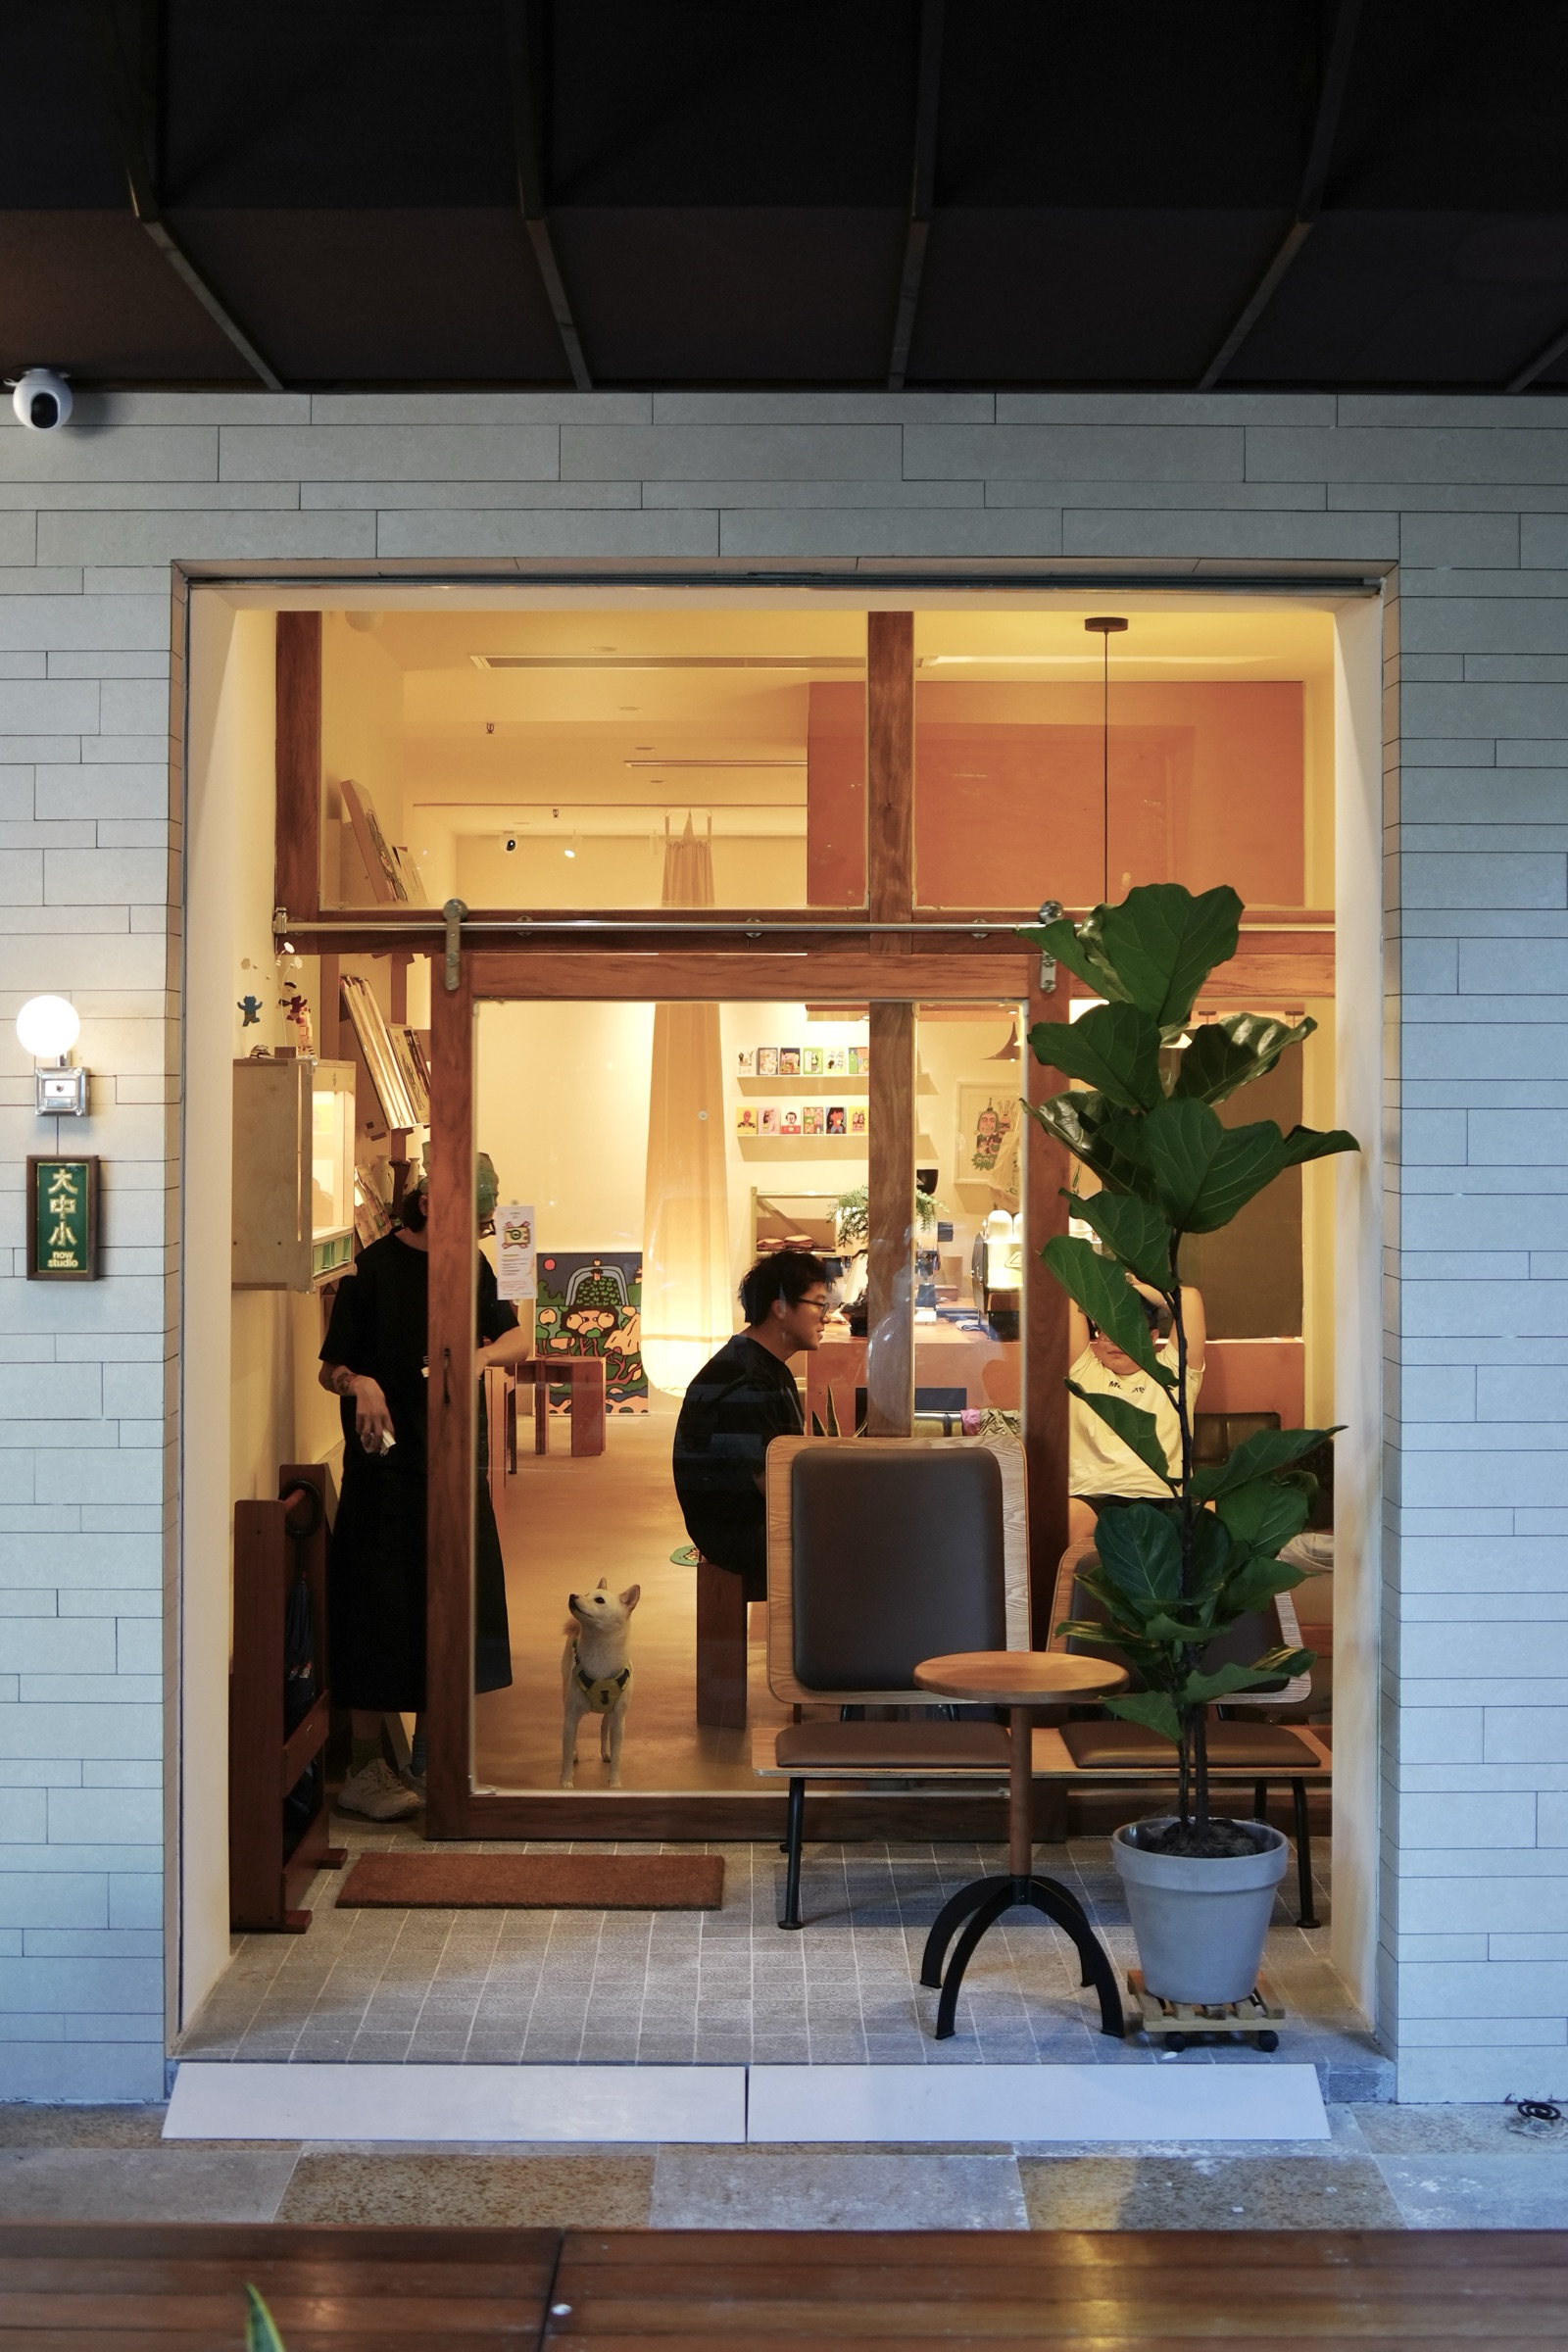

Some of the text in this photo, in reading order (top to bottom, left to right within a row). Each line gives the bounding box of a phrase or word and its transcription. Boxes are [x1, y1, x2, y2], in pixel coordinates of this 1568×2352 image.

[48, 1168, 78, 1247] 大中小
[52, 1250, 74, 1259] now
[47, 1258, 78, 1267] studio
